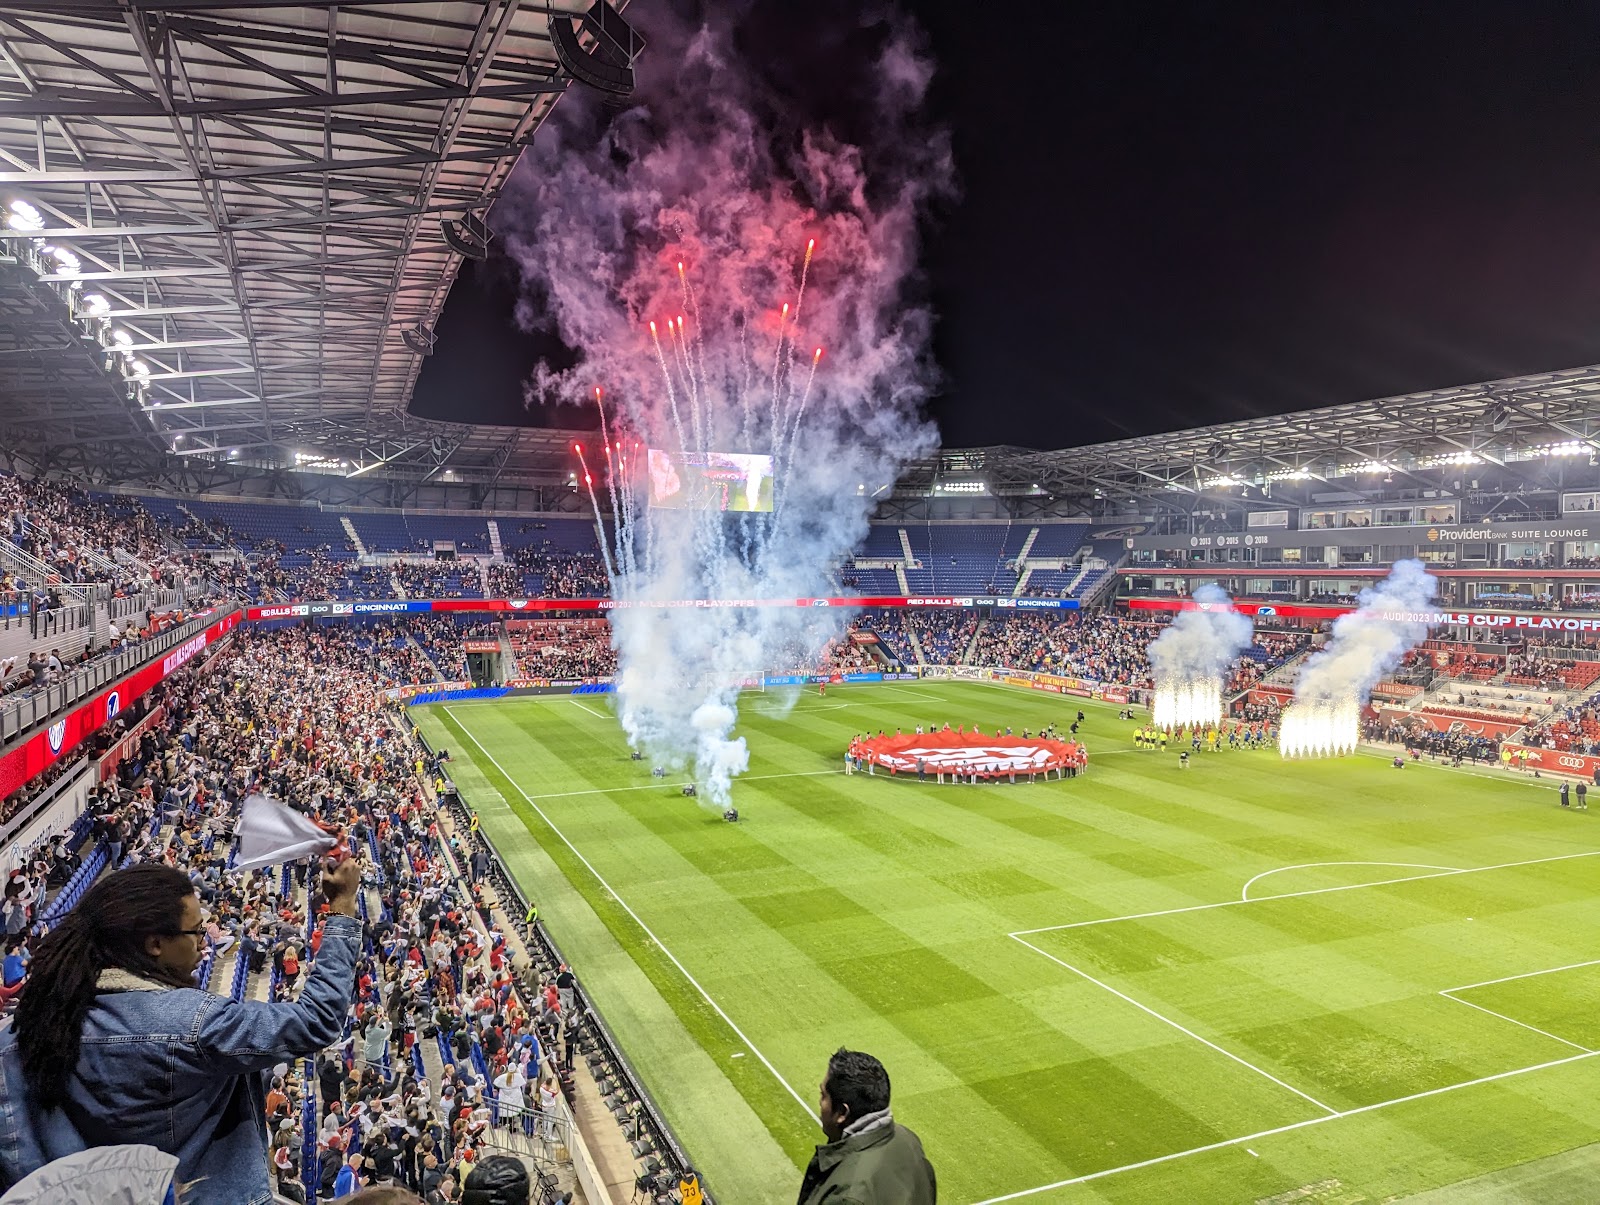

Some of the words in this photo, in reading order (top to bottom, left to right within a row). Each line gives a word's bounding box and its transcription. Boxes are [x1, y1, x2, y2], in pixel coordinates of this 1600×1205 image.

[1439, 527, 1492, 541] Provident
[1511, 530, 1541, 539] SUITE
[1544, 529, 1589, 538] LOUNGE
[1198, 537, 1211, 546] 2013
[1226, 537, 1239, 545] 2015
[1254, 536, 1268, 544] 2018
[355, 603, 408, 612] CINCINNATI
[695, 599, 755, 608] PLAYOFFS
[1018, 600, 1060, 608] CINCINNATI
[260, 609, 271, 618] RED
[271, 608, 290, 616] BULLS
[1382, 611, 1404, 621] AUDI
[1407, 613, 1430, 623] 2023
[1433, 613, 1470, 625] MLS
[1472, 614, 1512, 627] CUP
[1440, 643, 1456, 652] Red
[1457, 644, 1477, 653] Bulls
[684, 1186, 696, 1198] 73
